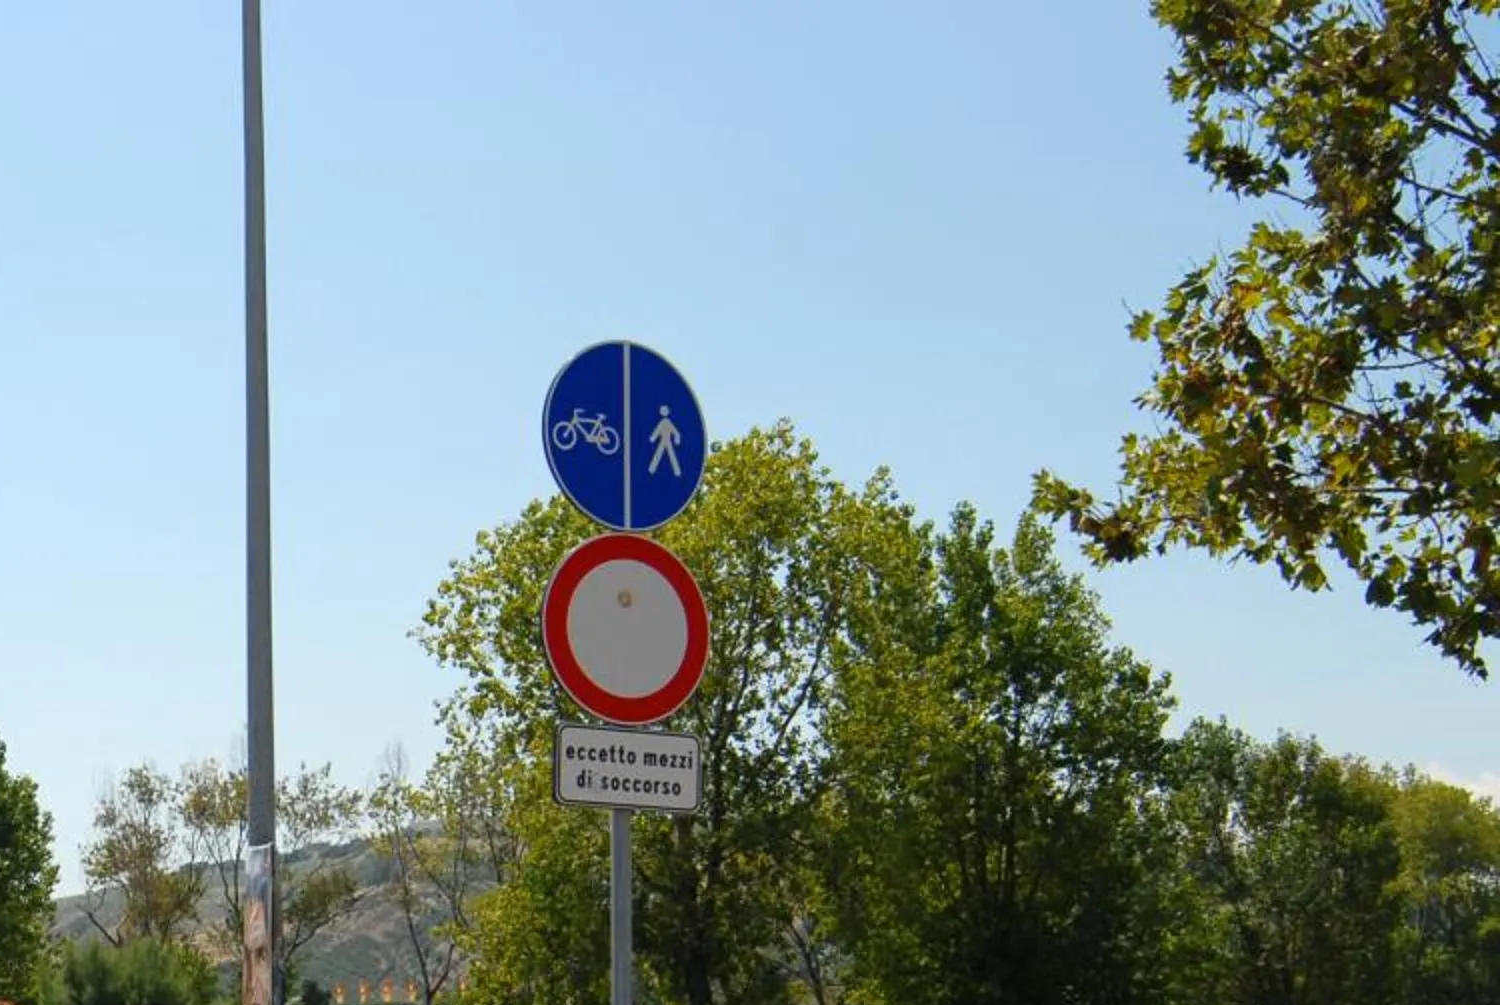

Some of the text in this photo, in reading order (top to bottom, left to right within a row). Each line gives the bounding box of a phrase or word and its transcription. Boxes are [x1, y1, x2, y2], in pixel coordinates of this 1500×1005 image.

[566, 745, 693, 770] eccetto mezzi
[576, 769, 682, 796] di soccorso
